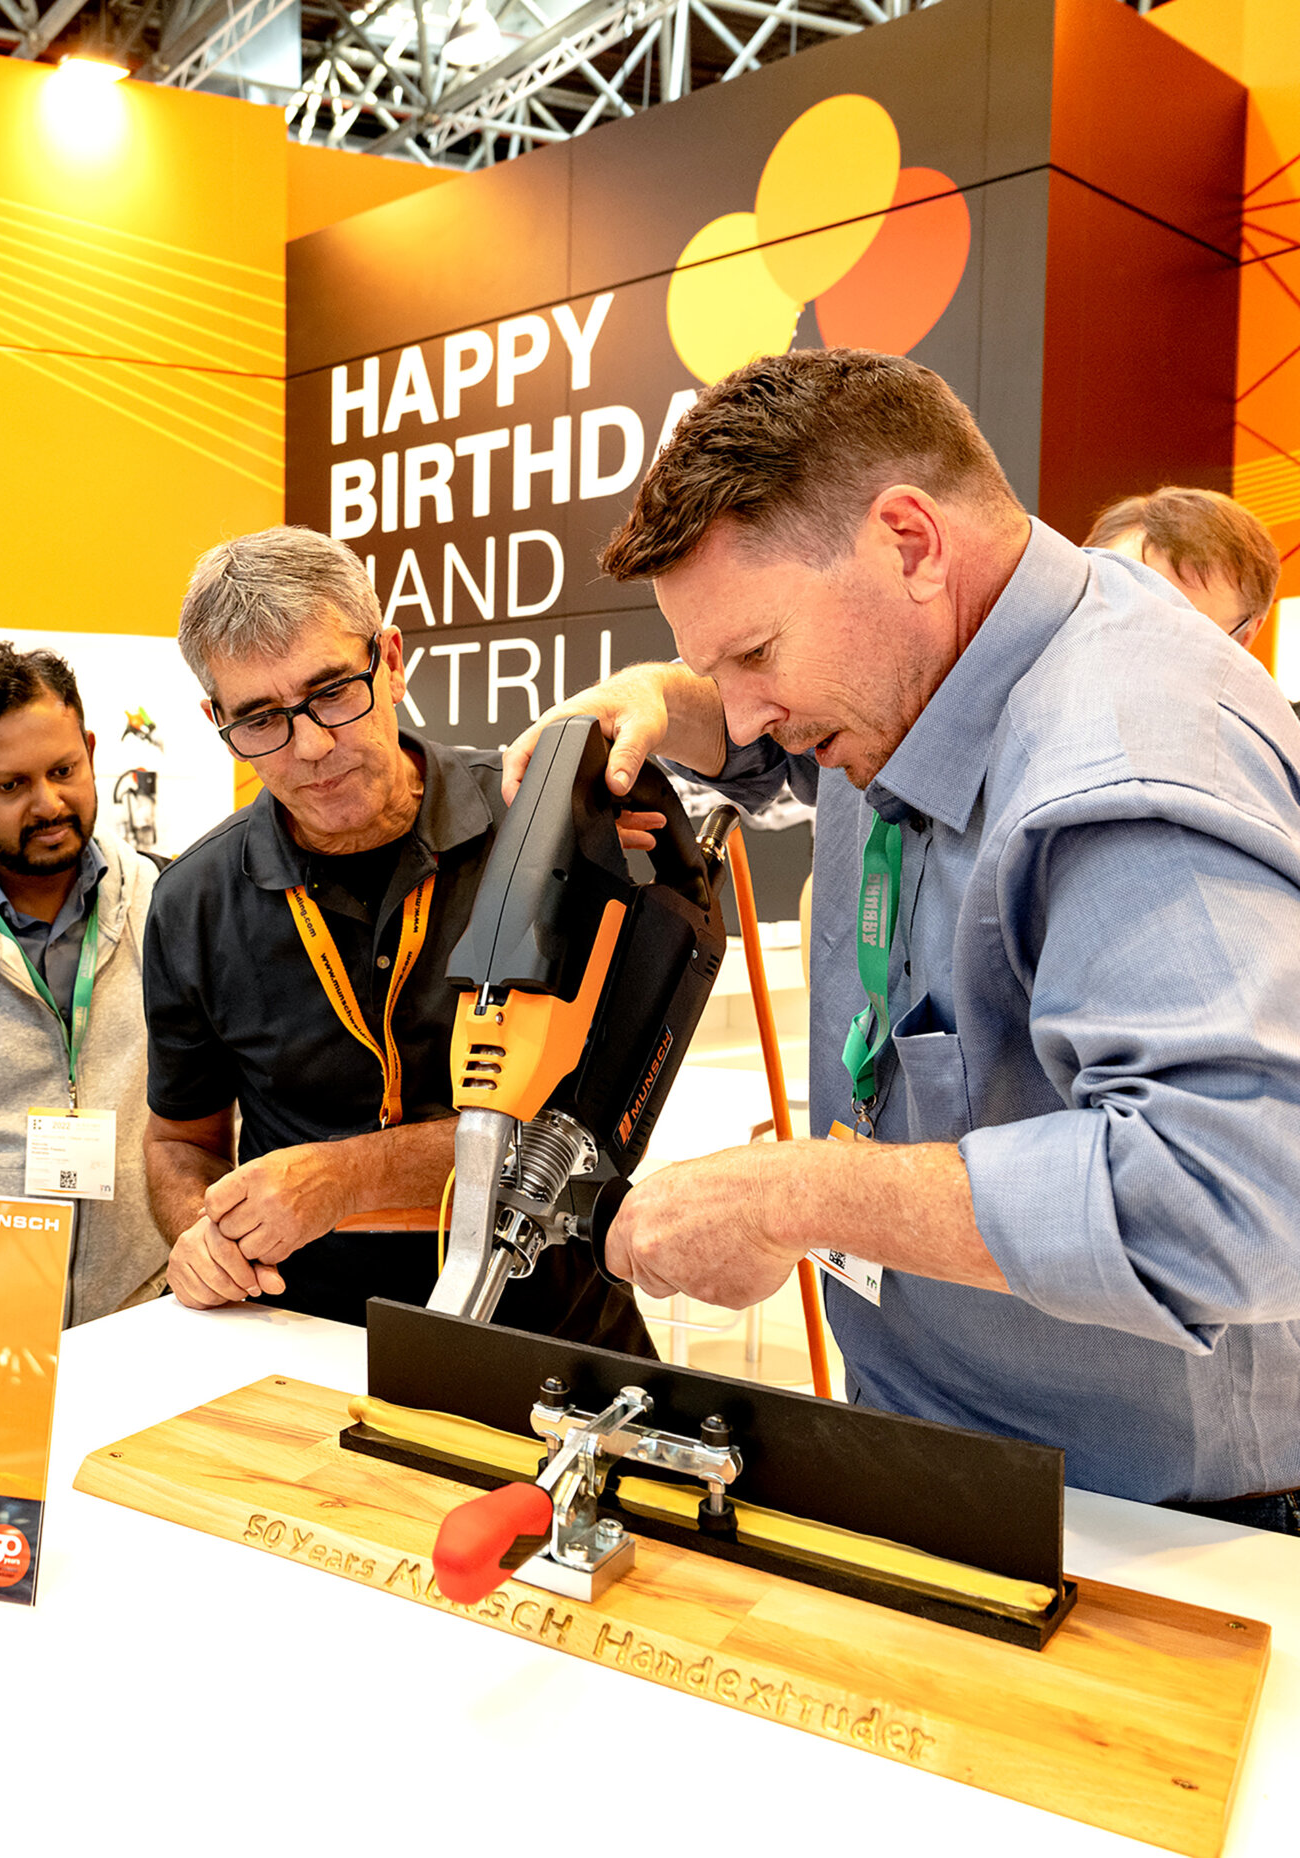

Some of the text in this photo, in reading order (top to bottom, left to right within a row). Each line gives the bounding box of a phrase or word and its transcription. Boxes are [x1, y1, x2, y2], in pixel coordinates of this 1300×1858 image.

[331, 292, 615, 446] HAPPY
[862, 873, 882, 947] ARBURG
[630, 1032, 672, 1120] MUNSCH
[244, 1513, 936, 1762] 50 Years MSCH Handextruder
